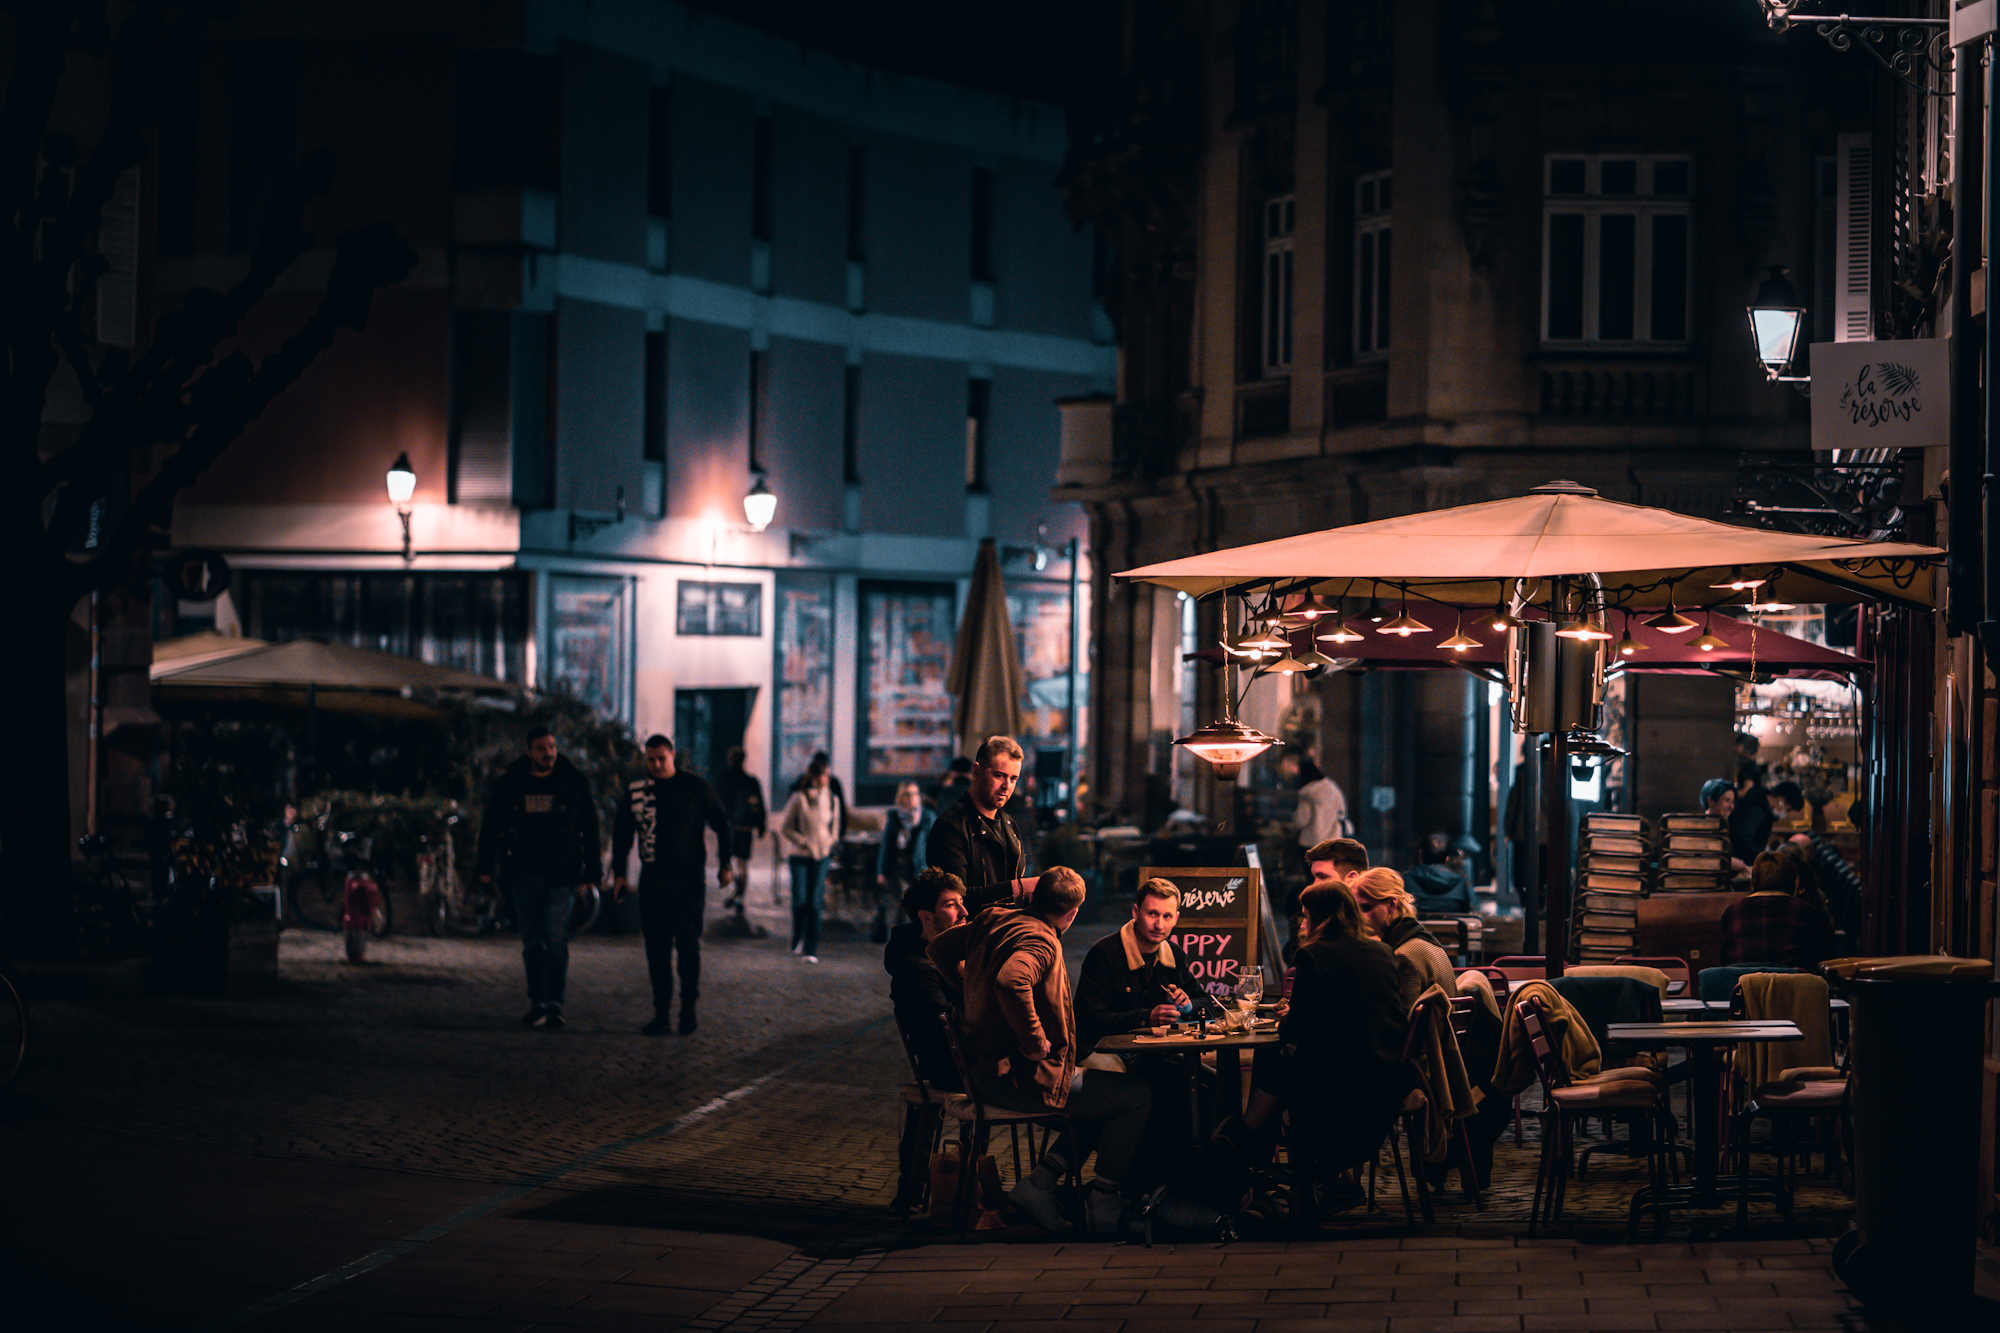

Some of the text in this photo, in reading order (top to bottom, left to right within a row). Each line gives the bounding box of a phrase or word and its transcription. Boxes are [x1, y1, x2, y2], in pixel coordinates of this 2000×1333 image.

[1855, 364, 1876, 398] la
[1849, 397, 1922, 427] réserve
[1181, 887, 1236, 910] réserve
[1189, 959, 1239, 979] OUR
